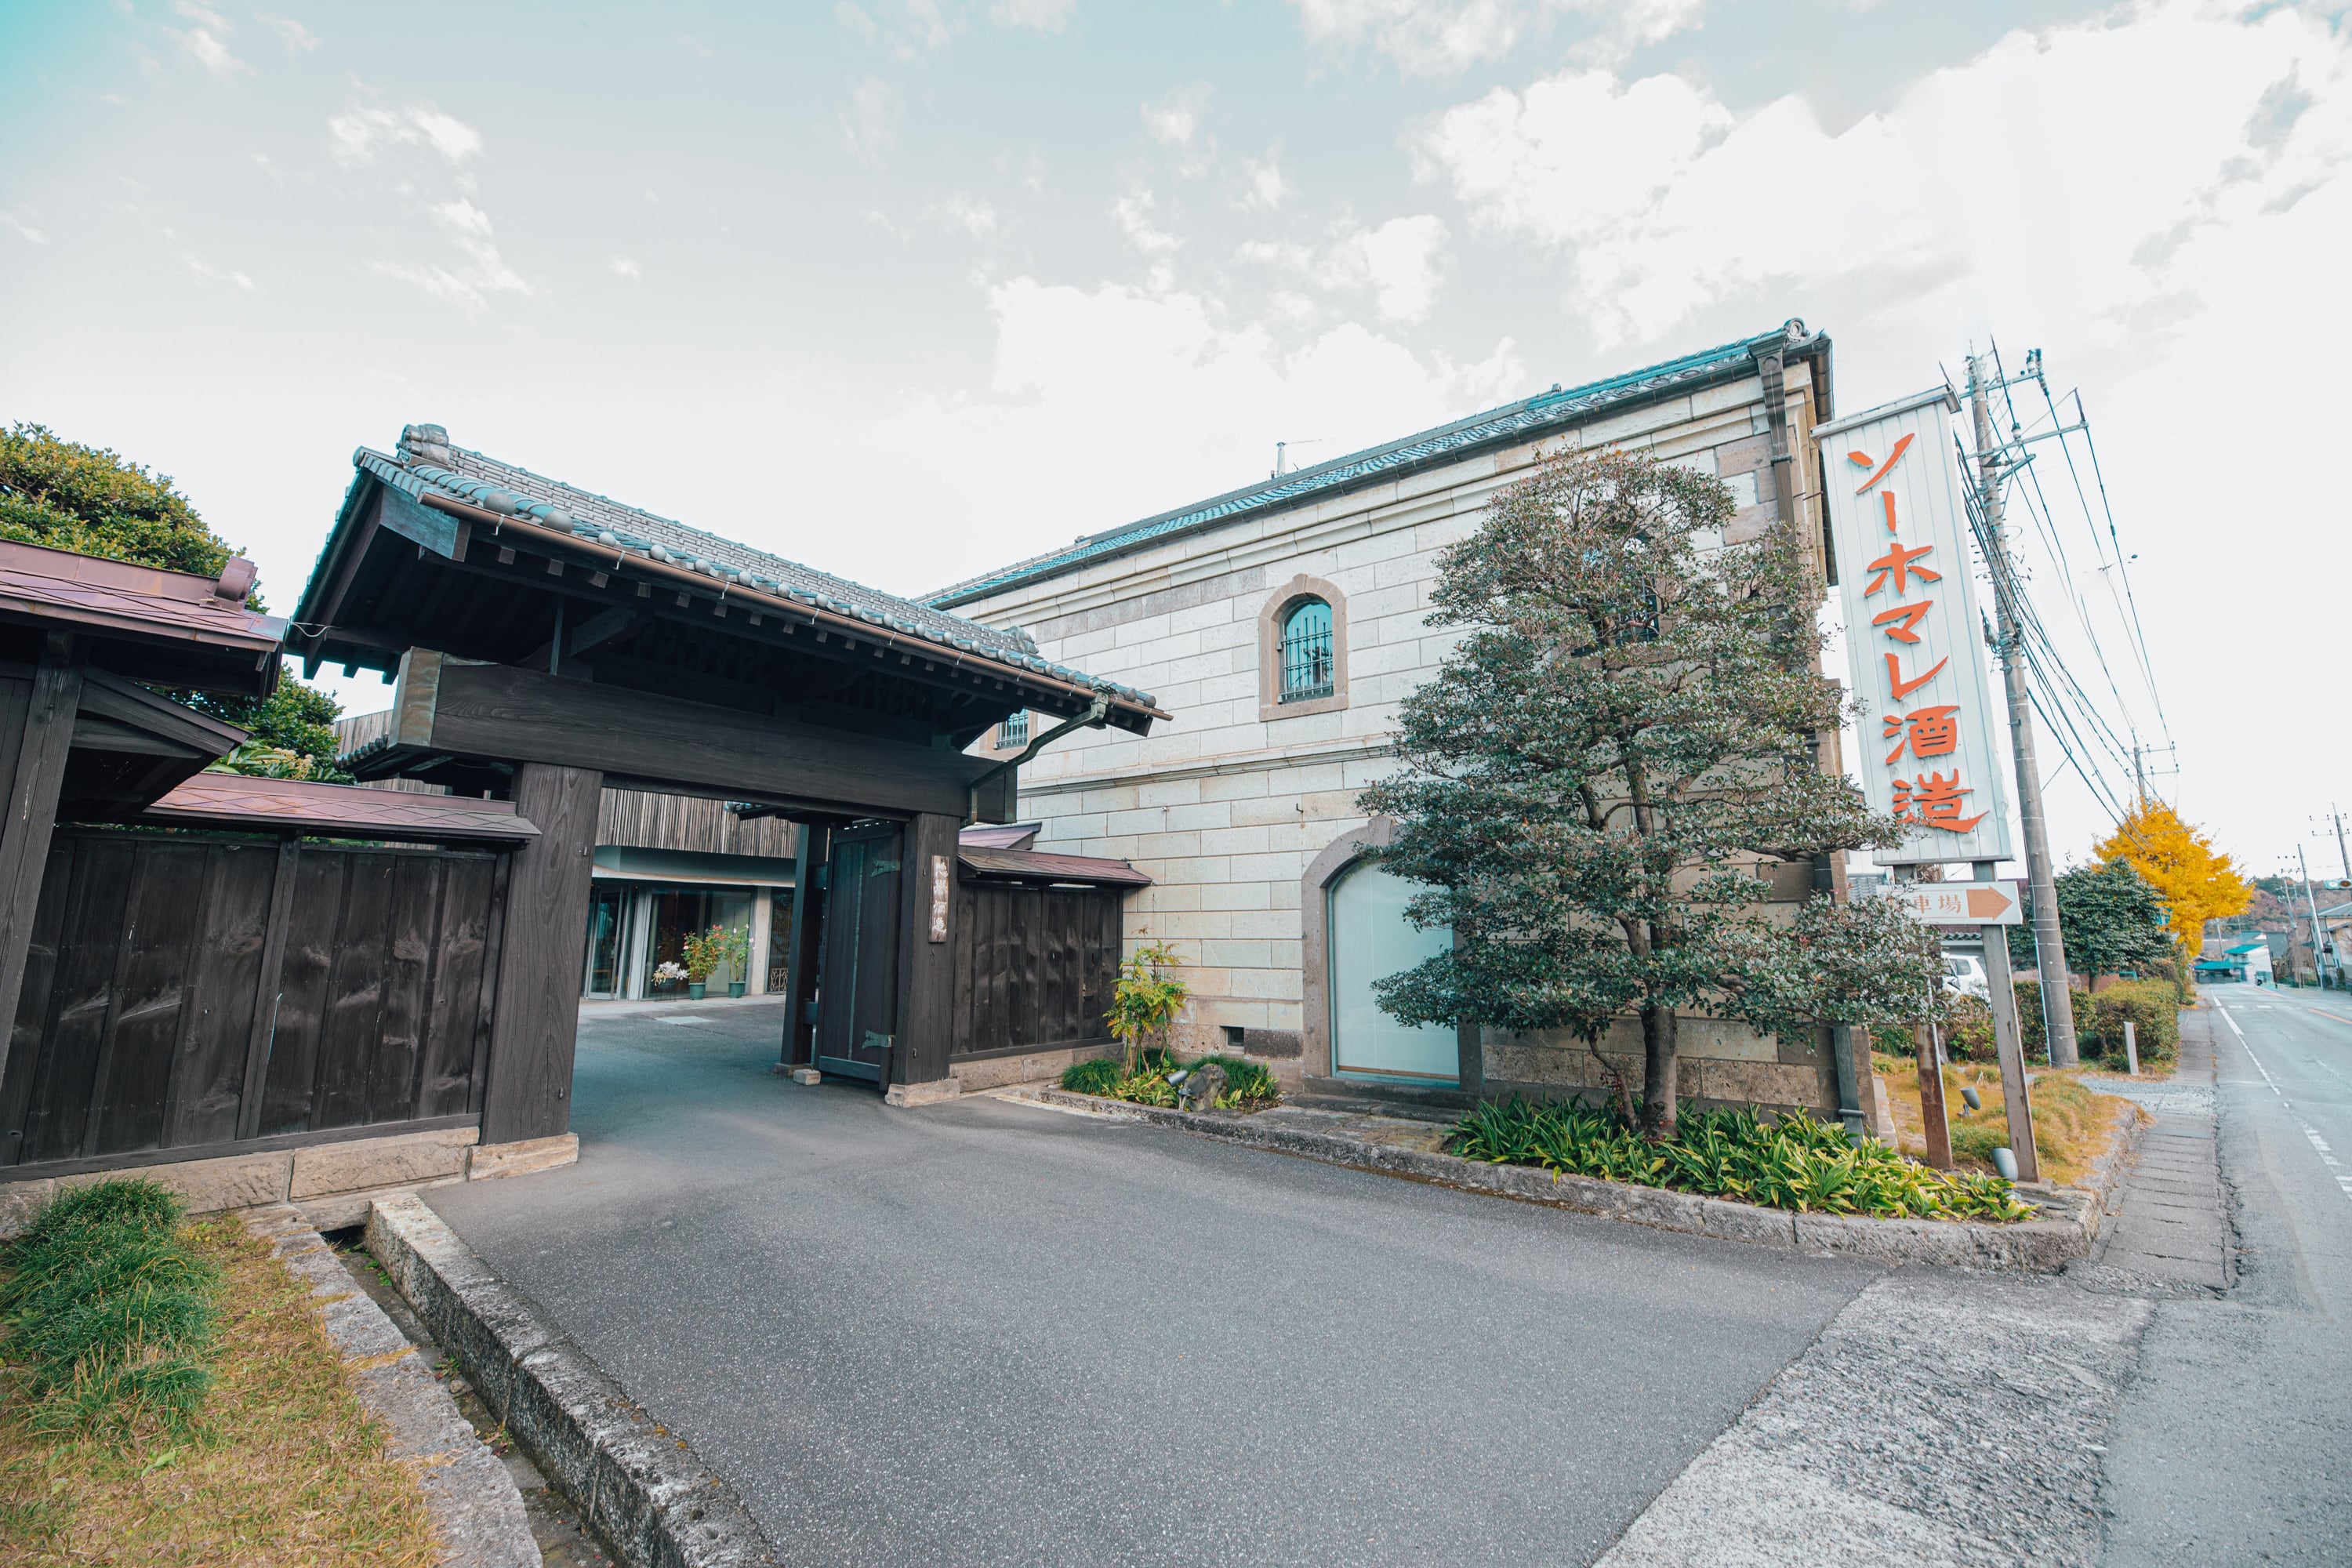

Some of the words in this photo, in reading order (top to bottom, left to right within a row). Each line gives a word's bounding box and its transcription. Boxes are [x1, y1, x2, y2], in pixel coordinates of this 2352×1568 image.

[1847, 433, 1990, 834] ソーホマレ酒造
[1887, 894, 1962, 914] 車場
